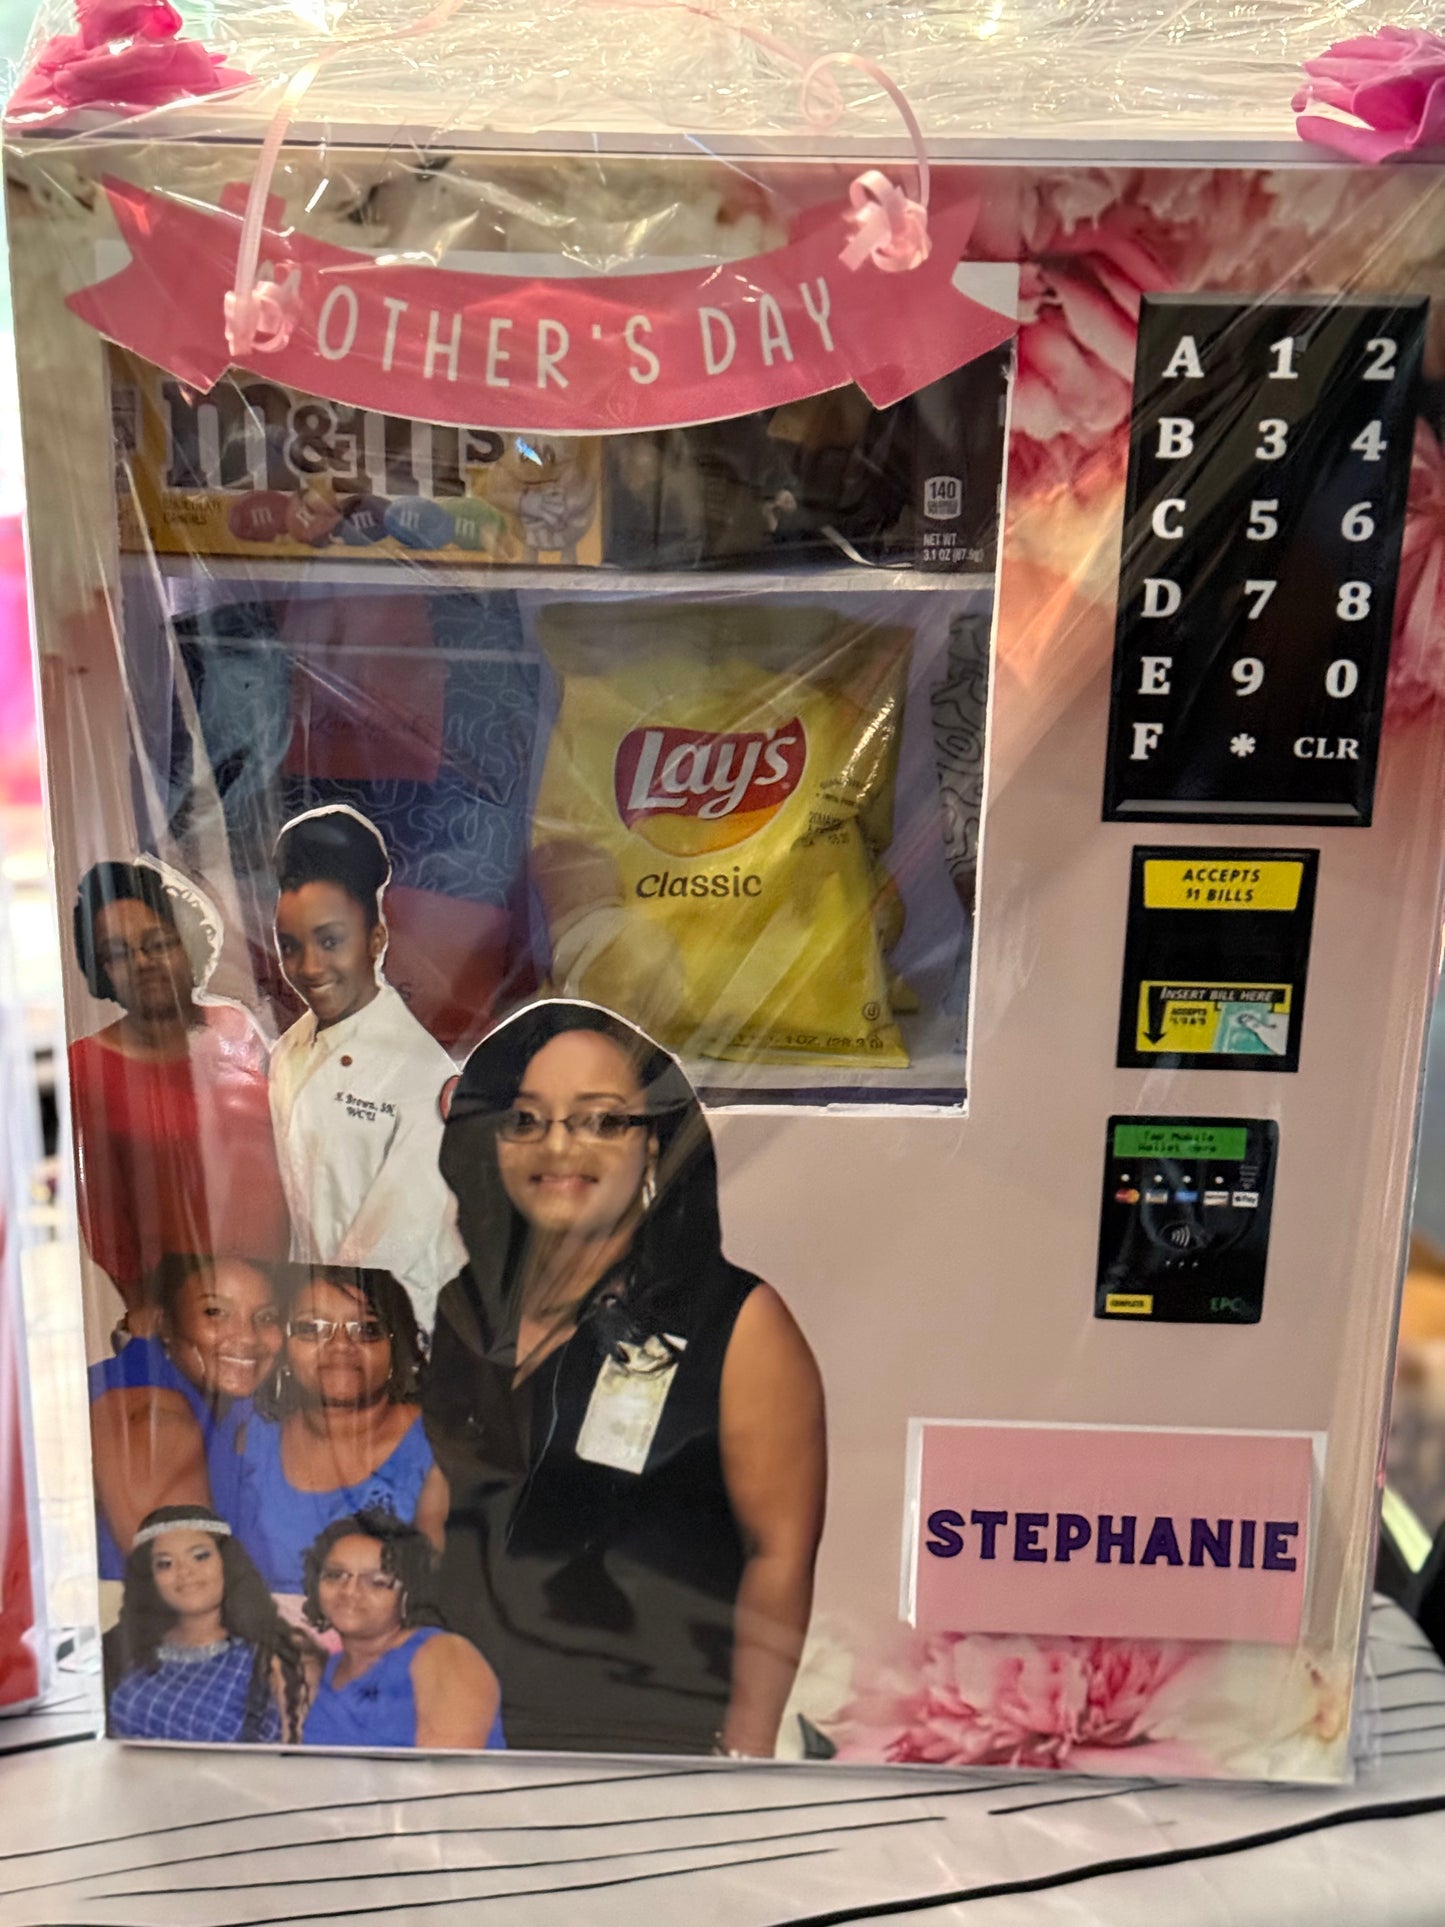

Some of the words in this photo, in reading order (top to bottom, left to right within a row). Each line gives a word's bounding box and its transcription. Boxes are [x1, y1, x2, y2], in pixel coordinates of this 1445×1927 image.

[698, 276, 834, 376] DAY
[1162, 335, 1205, 379] A
[1268, 336, 1298, 379] 1
[1363, 337, 1397, 381] 2
[162, 377, 505, 498] m&ms
[1155, 417, 1195, 460] B
[1255, 418, 1289, 461] 3
[1350, 419, 1387, 462] 4
[929, 481, 957, 499] 140
[923, 533, 941, 546] NET
[943, 533, 957, 546] WT
[1151, 498, 1186, 540] C
[1246, 498, 1280, 541] 5
[1341, 501, 1375, 542] 6
[923, 548, 937, 560] 3.1
[939, 548, 951, 560] OZ
[1140, 578, 1182, 618] D
[1244, 579, 1278, 620] 7
[1336, 581, 1372, 622] 8
[1138, 656, 1173, 695] E
[1231, 657, 1265, 697] 9
[1325, 658, 1359, 699] 0
[1129, 722, 1163, 760] F
[1293, 736, 1360, 760] CLR
[627, 728, 797, 820] Lay's
[636, 865, 763, 899] Classic
[1182, 868, 1261, 883] ACCEPTS
[1206, 889, 1254, 902] BILLS
[1160, 986, 1206, 1000] INSERT
[926, 1509, 1299, 1572] STEPHANIE
